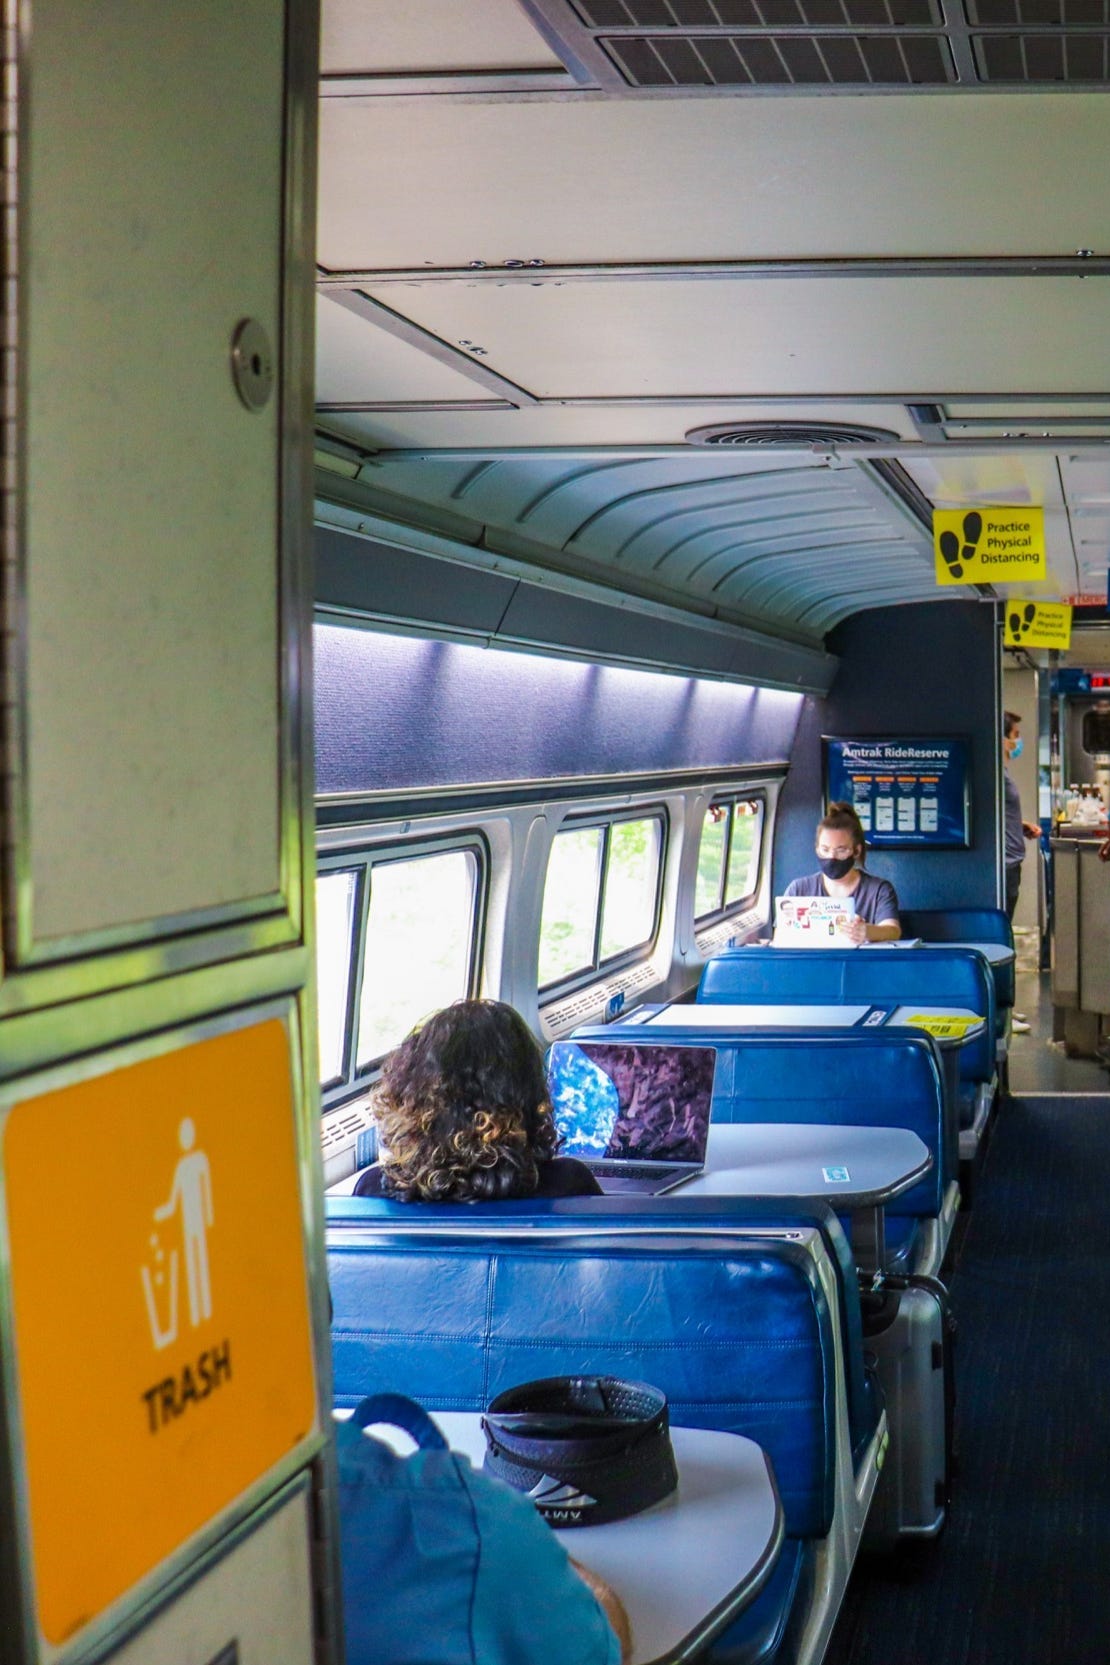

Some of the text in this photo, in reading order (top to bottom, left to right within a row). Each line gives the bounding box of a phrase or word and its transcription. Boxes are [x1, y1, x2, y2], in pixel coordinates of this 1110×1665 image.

[987, 523, 1030, 533] Practice
[987, 537, 1032, 550] Physical
[981, 553, 1040, 565] Distancing
[1037, 611, 1064, 620] Practice
[1037, 620, 1063, 629] Physical
[1031, 629, 1066, 639] Distancing
[842, 747, 950, 758] Amtrak RideReserve
[140, 1337, 232, 1436] TRASH
